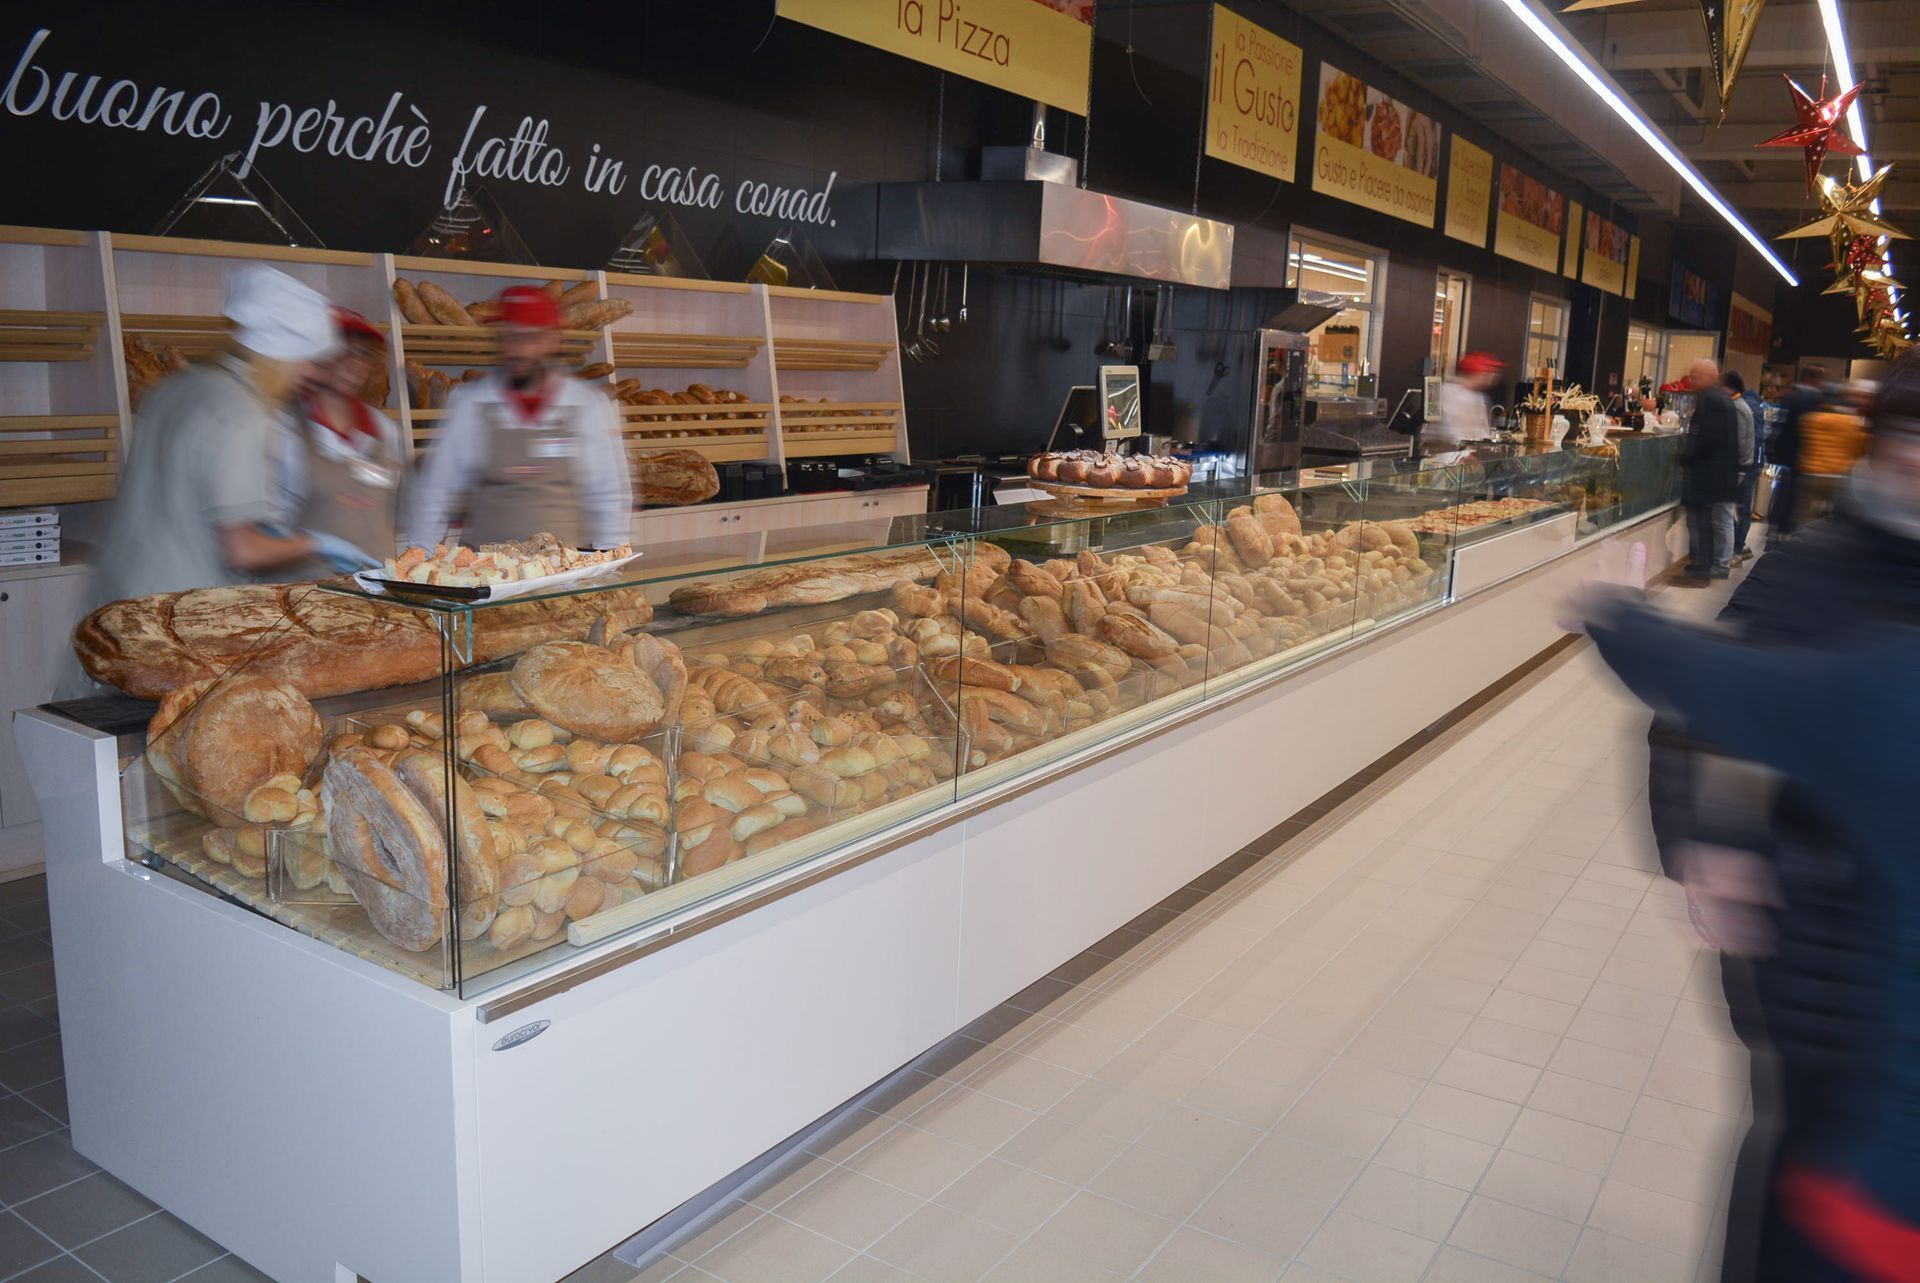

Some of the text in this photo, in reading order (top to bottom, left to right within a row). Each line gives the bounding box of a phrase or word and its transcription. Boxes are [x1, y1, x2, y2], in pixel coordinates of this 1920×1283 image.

[938, 0, 1010, 68] Pizza
[1249, 29, 1292, 76] Passione
[1212, 42, 1294, 133] il Gusto
[1, 28, 837, 227] buono perchè fatto in casa conad.
[1216, 116, 1289, 172] la Tradizione
[1317, 145, 1347, 188] Gusto
[1349, 168, 1357, 190] e
